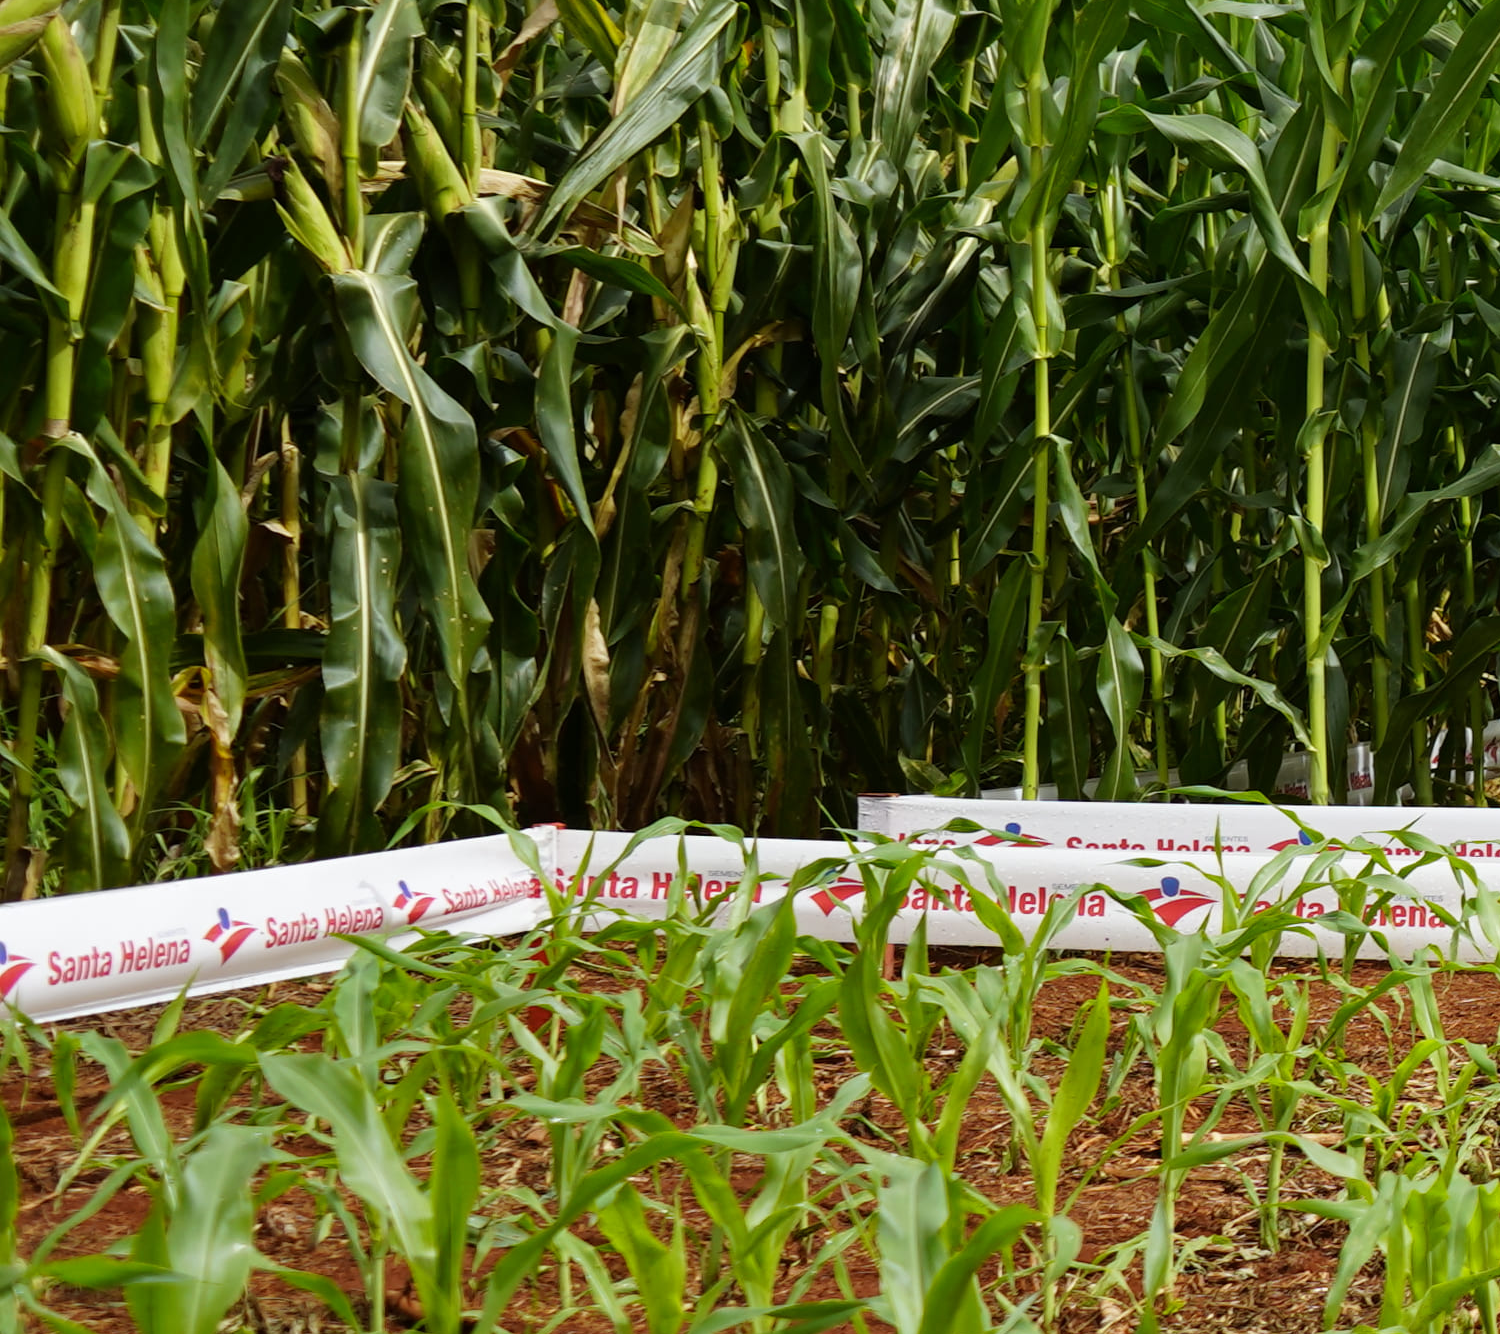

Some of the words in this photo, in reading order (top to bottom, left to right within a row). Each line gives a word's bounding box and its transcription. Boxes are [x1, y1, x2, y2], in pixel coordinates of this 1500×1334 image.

[442, 884, 487, 915] Santa
[488, 877, 540, 903] Helena
[265, 911, 318, 949] Santa
[325, 905, 384, 937] Helena
[48, 947, 112, 985] Santa
[119, 937, 190, 974] Helena
